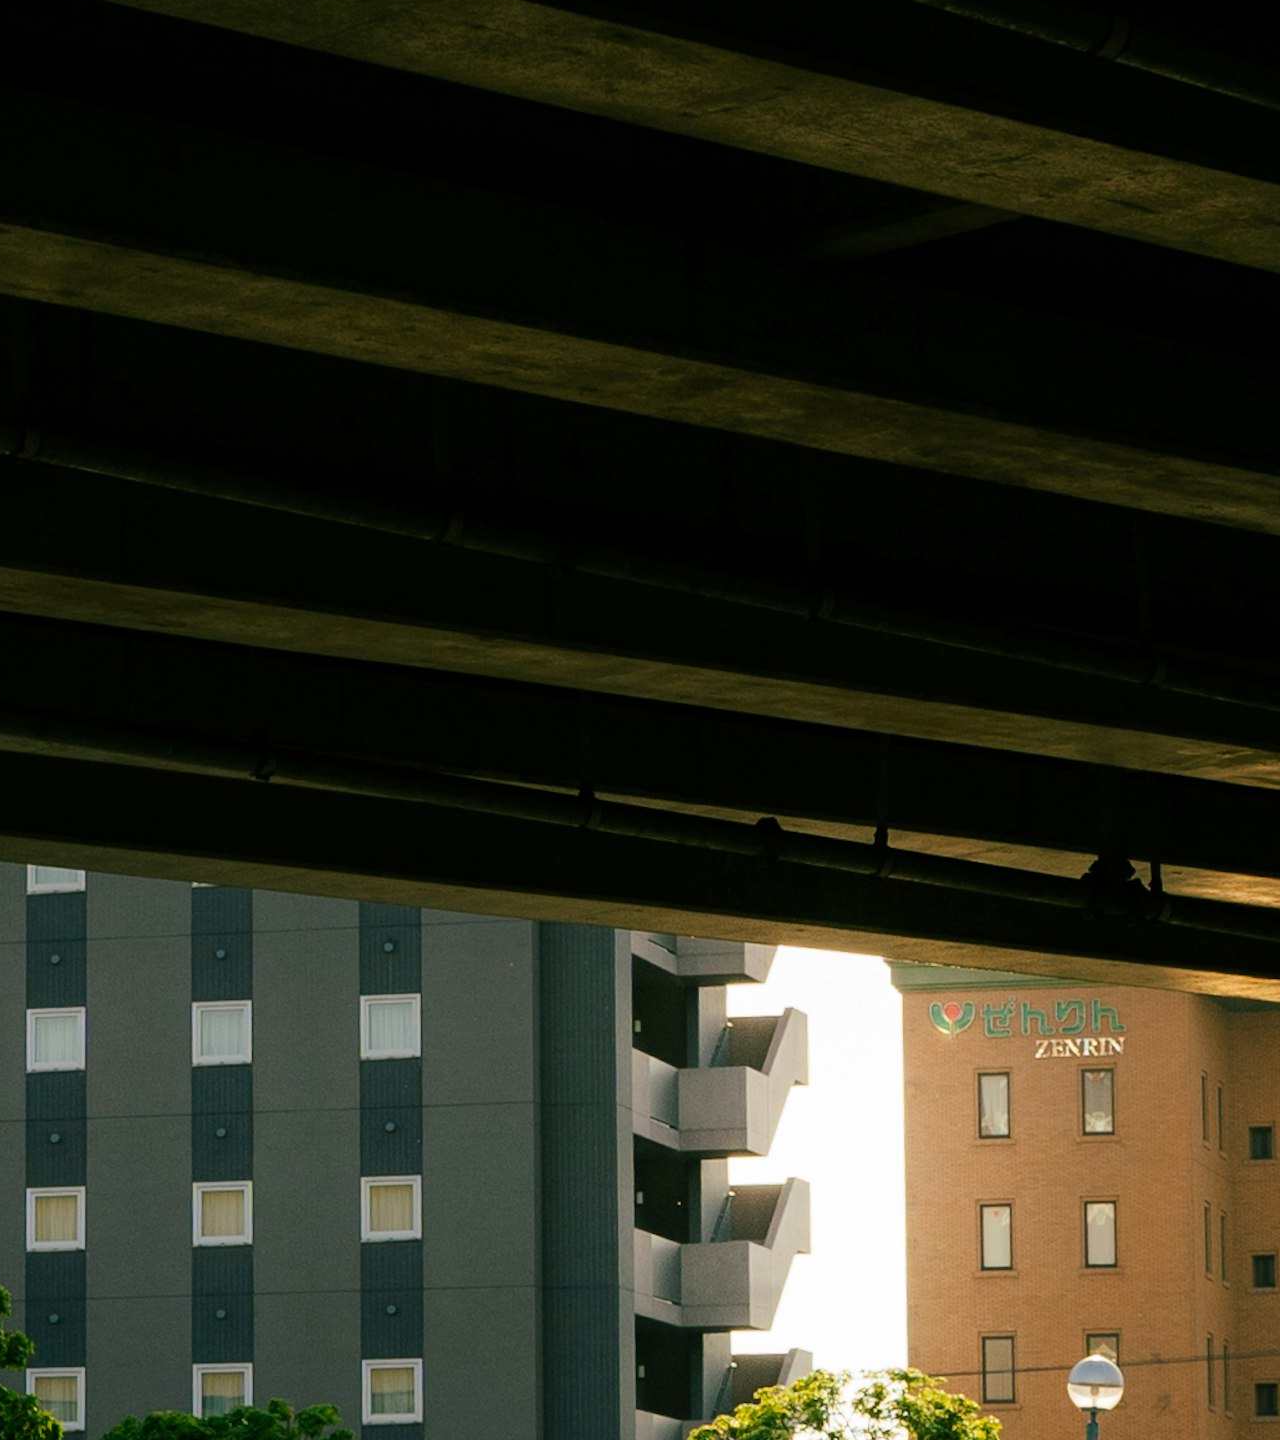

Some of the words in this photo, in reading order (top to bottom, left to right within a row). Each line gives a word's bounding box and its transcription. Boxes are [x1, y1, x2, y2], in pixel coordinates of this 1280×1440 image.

[980, 996, 1127, 1038] ぜんりん
[1034, 1036, 1126, 1059] ZENRIN
